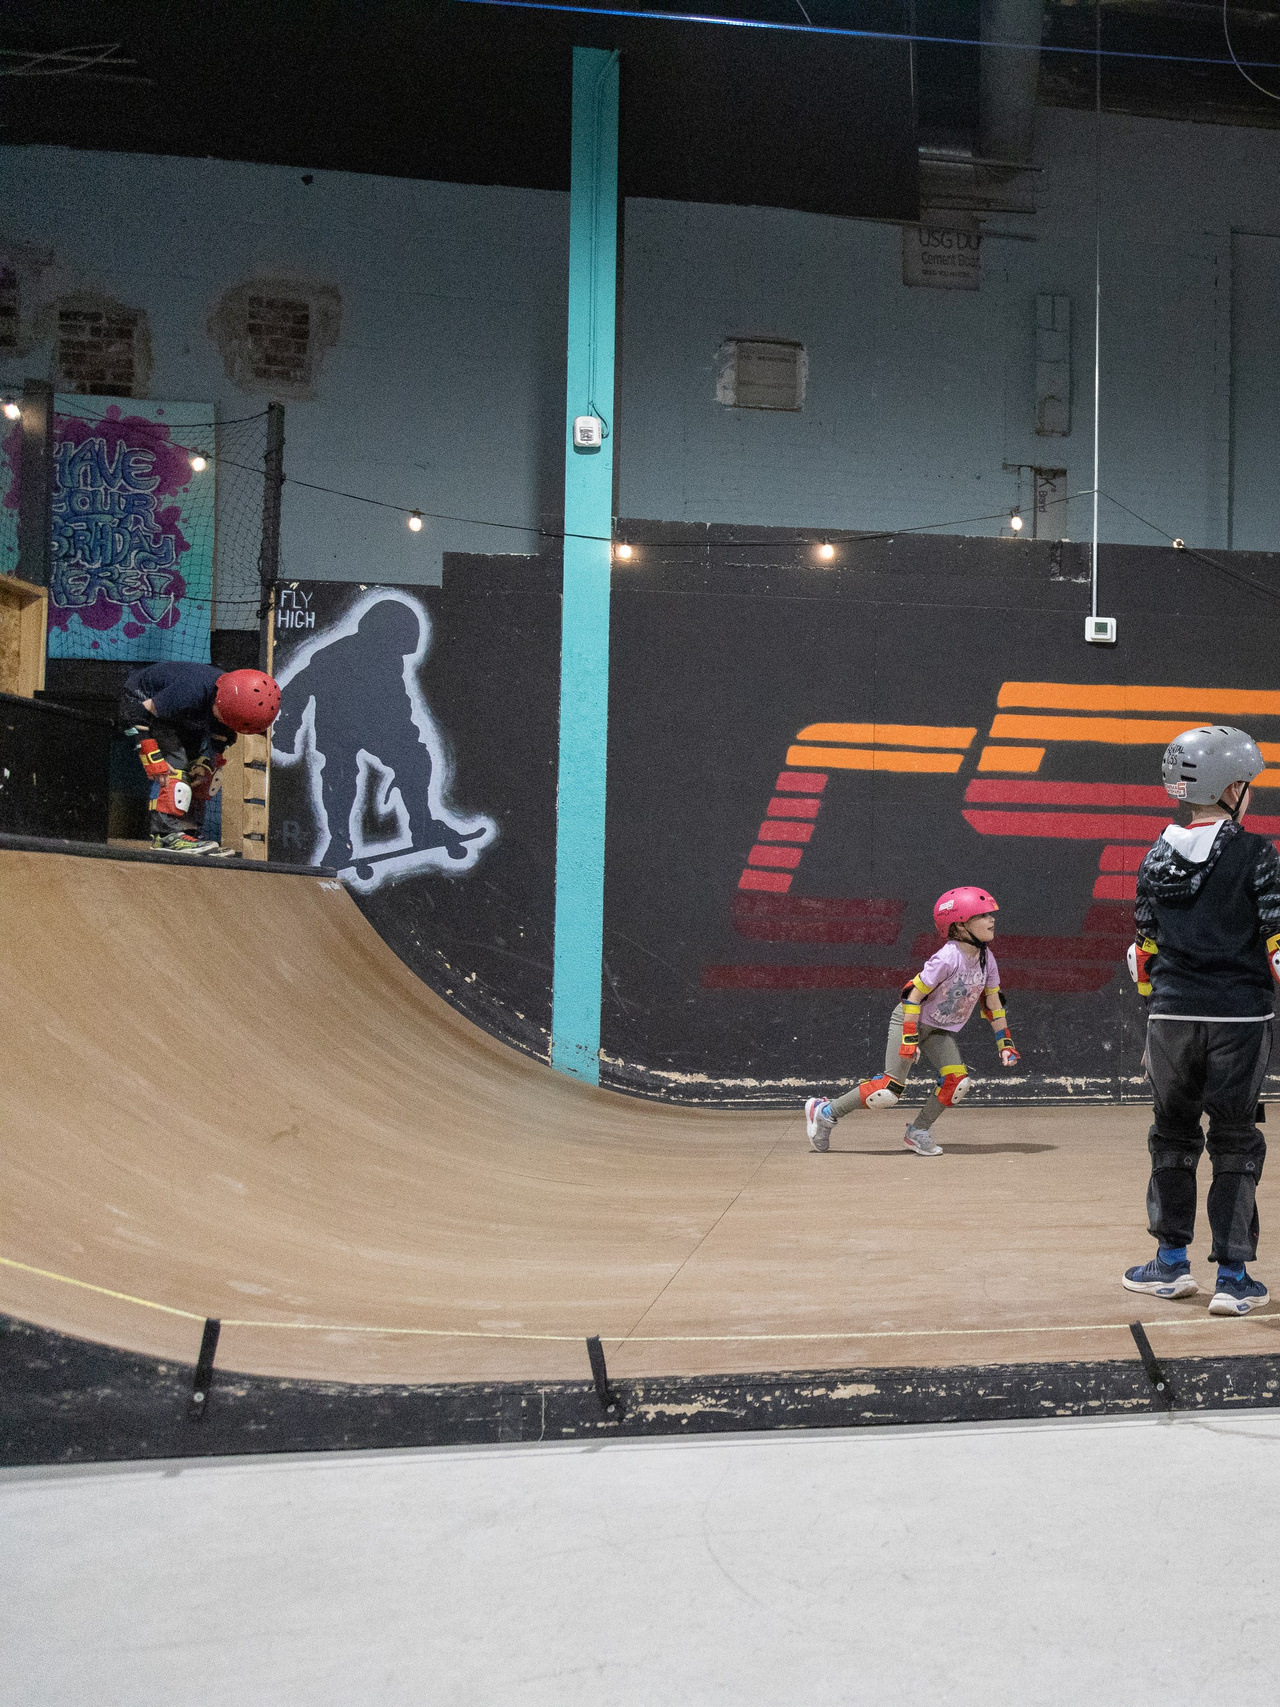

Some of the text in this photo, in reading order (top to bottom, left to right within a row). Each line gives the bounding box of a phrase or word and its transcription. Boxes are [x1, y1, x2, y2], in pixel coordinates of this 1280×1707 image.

[919, 227, 953, 249] USG
[281, 590, 313, 609] FLY
[278, 609, 316, 629] HIGH
